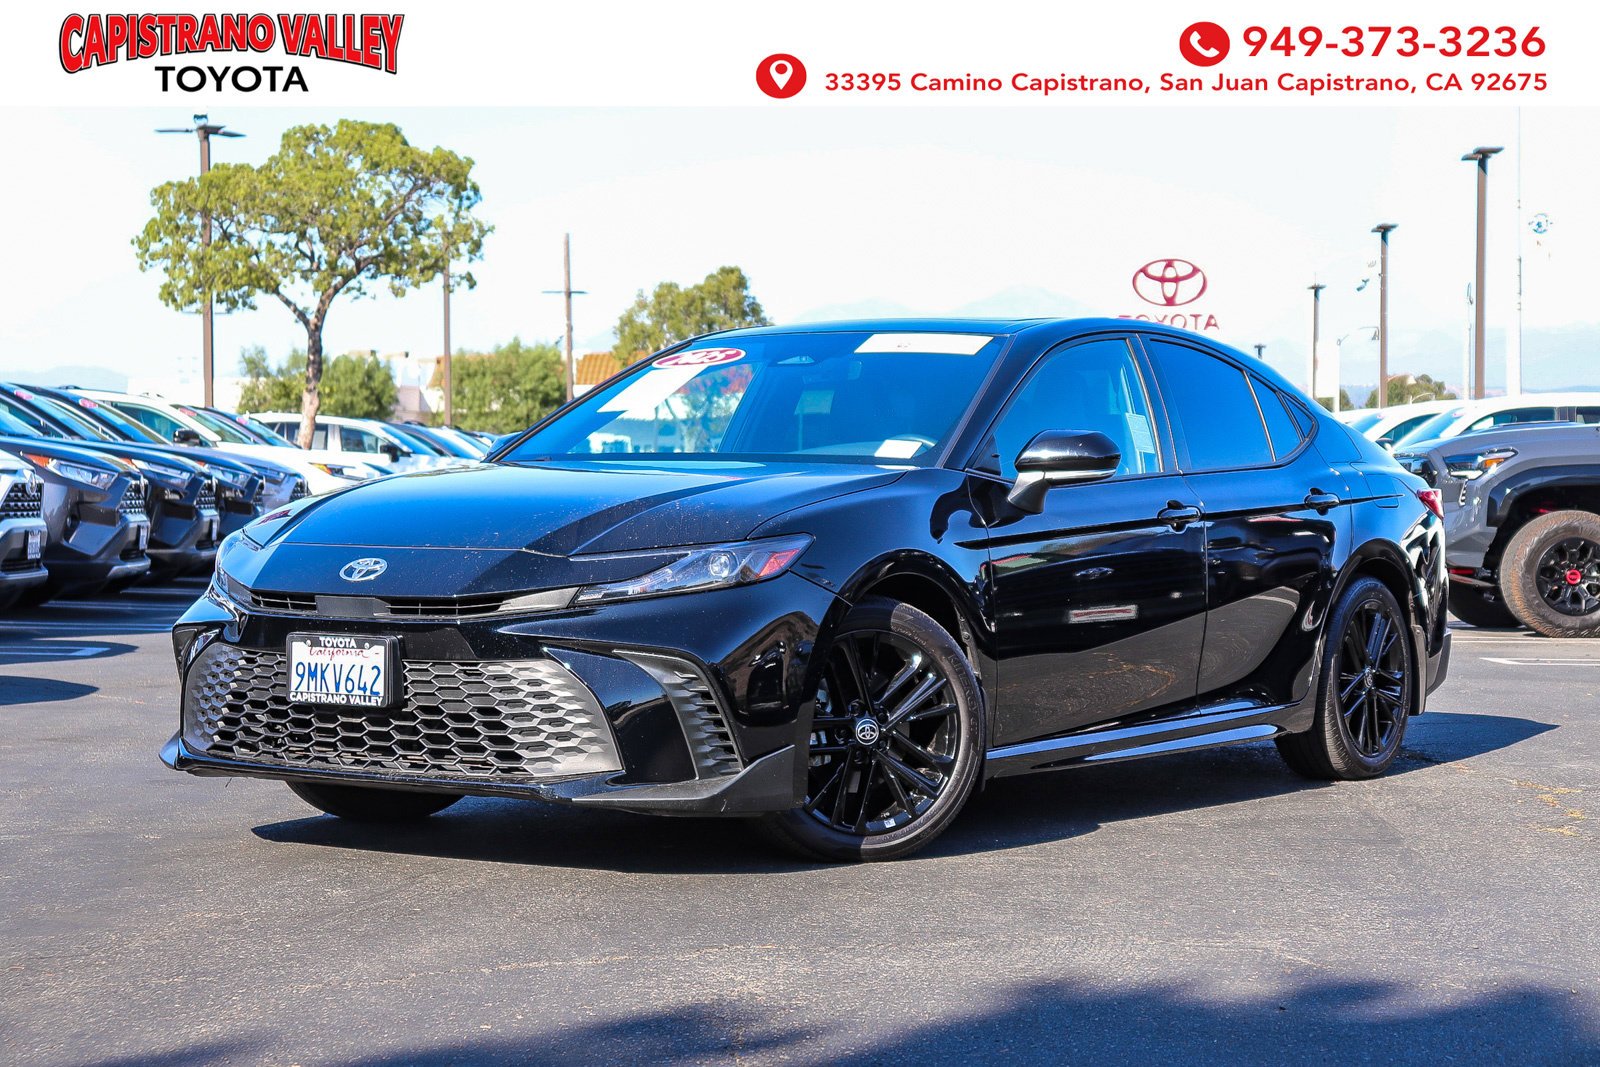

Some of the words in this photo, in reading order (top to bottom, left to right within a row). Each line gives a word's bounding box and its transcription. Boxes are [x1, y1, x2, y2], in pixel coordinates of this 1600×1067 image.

[1118, 313, 1220, 330] YOTA
[319, 636, 357, 648] TOYOTA
[295, 661, 382, 696] 9MKV642
[290, 691, 347, 704] CAPISTRANO
[349, 695, 383, 706] VALLEY
